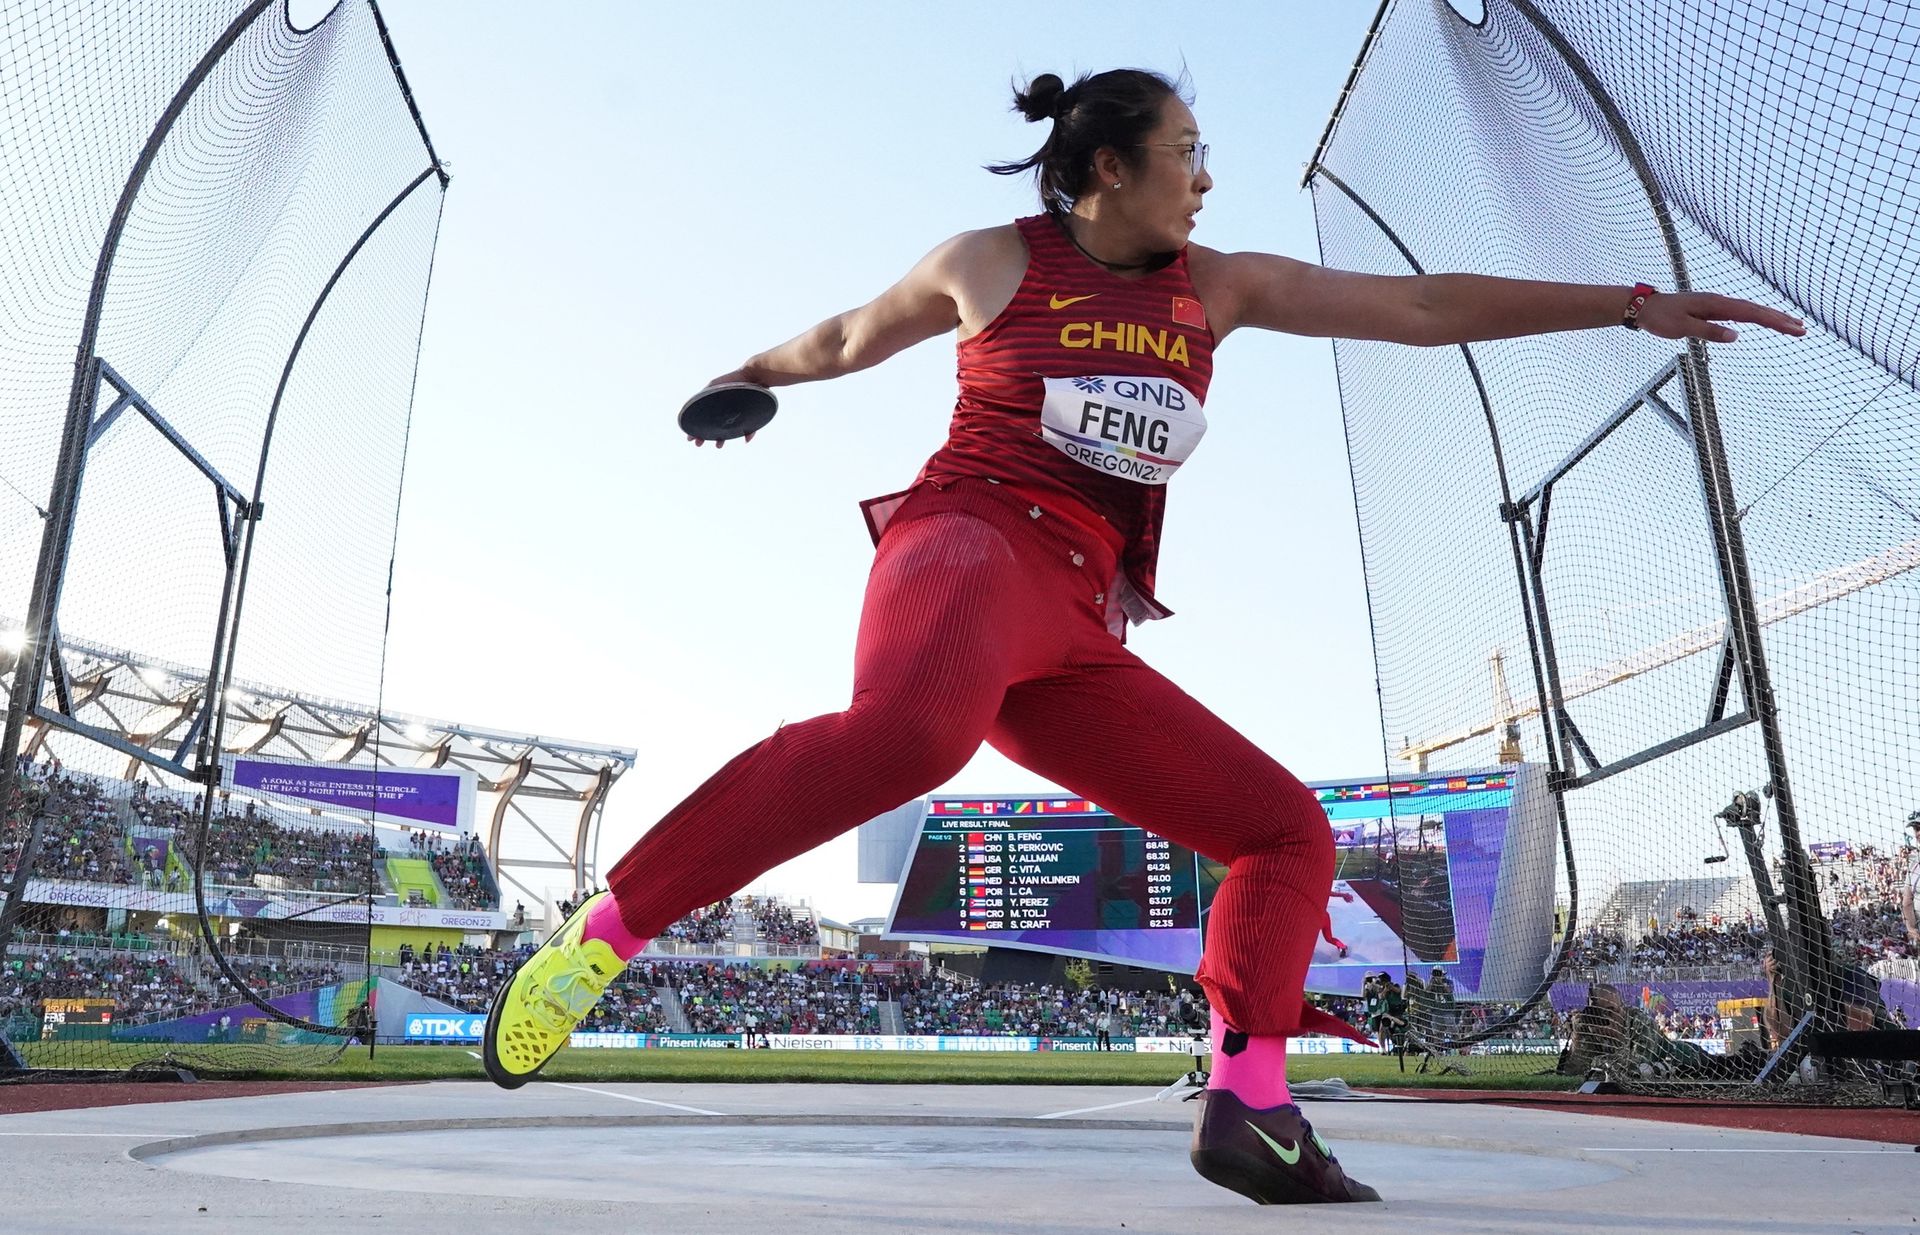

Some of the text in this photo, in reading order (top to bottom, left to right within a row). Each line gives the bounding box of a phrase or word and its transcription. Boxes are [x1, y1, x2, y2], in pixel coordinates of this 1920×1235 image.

[1060, 321, 1190, 368] CHINA
[1114, 380, 1186, 412] QNB
[1078, 400, 1170, 455] FENG
[1065, 443, 1162, 481] OREGON22
[1008, 833, 1016, 841] B.
[1018, 833, 1042, 841] FENG
[958, 844, 966, 852] 2
[1018, 843, 1064, 852] PERKOVIC
[1146, 841, 1169, 850] 68.45
[984, 855, 1002, 863] USA
[1019, 854, 1058, 862] ALLMAN
[1146, 852, 1170, 860] 68.30
[985, 866, 1002, 874] GER
[1146, 863, 1170, 872] 64.24
[960, 877, 966, 885] 5
[985, 877, 1002, 885] NED
[1019, 876, 1039, 884] VAN
[1040, 876, 1080, 884] KLINKEN
[1148, 874, 1171, 882] 64.00
[960, 888, 966, 896] 6
[986, 888, 1002, 896] POR
[1148, 886, 1172, 894] 63.99
[960, 896, 1172, 907] 7 CUB Y. PEREZ 63.07
[960, 908, 1172, 918] 8 CRO M. TOLJ 63.07
[960, 920, 1174, 929] 9 GER S. CRAFT 62.35
[44, 1012, 66, 1022] FENG
[422, 1019, 464, 1036] TDK
[660, 1038, 698, 1048] Pinsent
[774, 1037, 833, 1049] Nielsen
[855, 1038, 883, 1050] TBS
[897, 1038, 926, 1050] TBS
[961, 1038, 1030, 1051] MONDO
[1053, 1040, 1092, 1051] Pinsent
[1296, 1040, 1328, 1054] TBS
